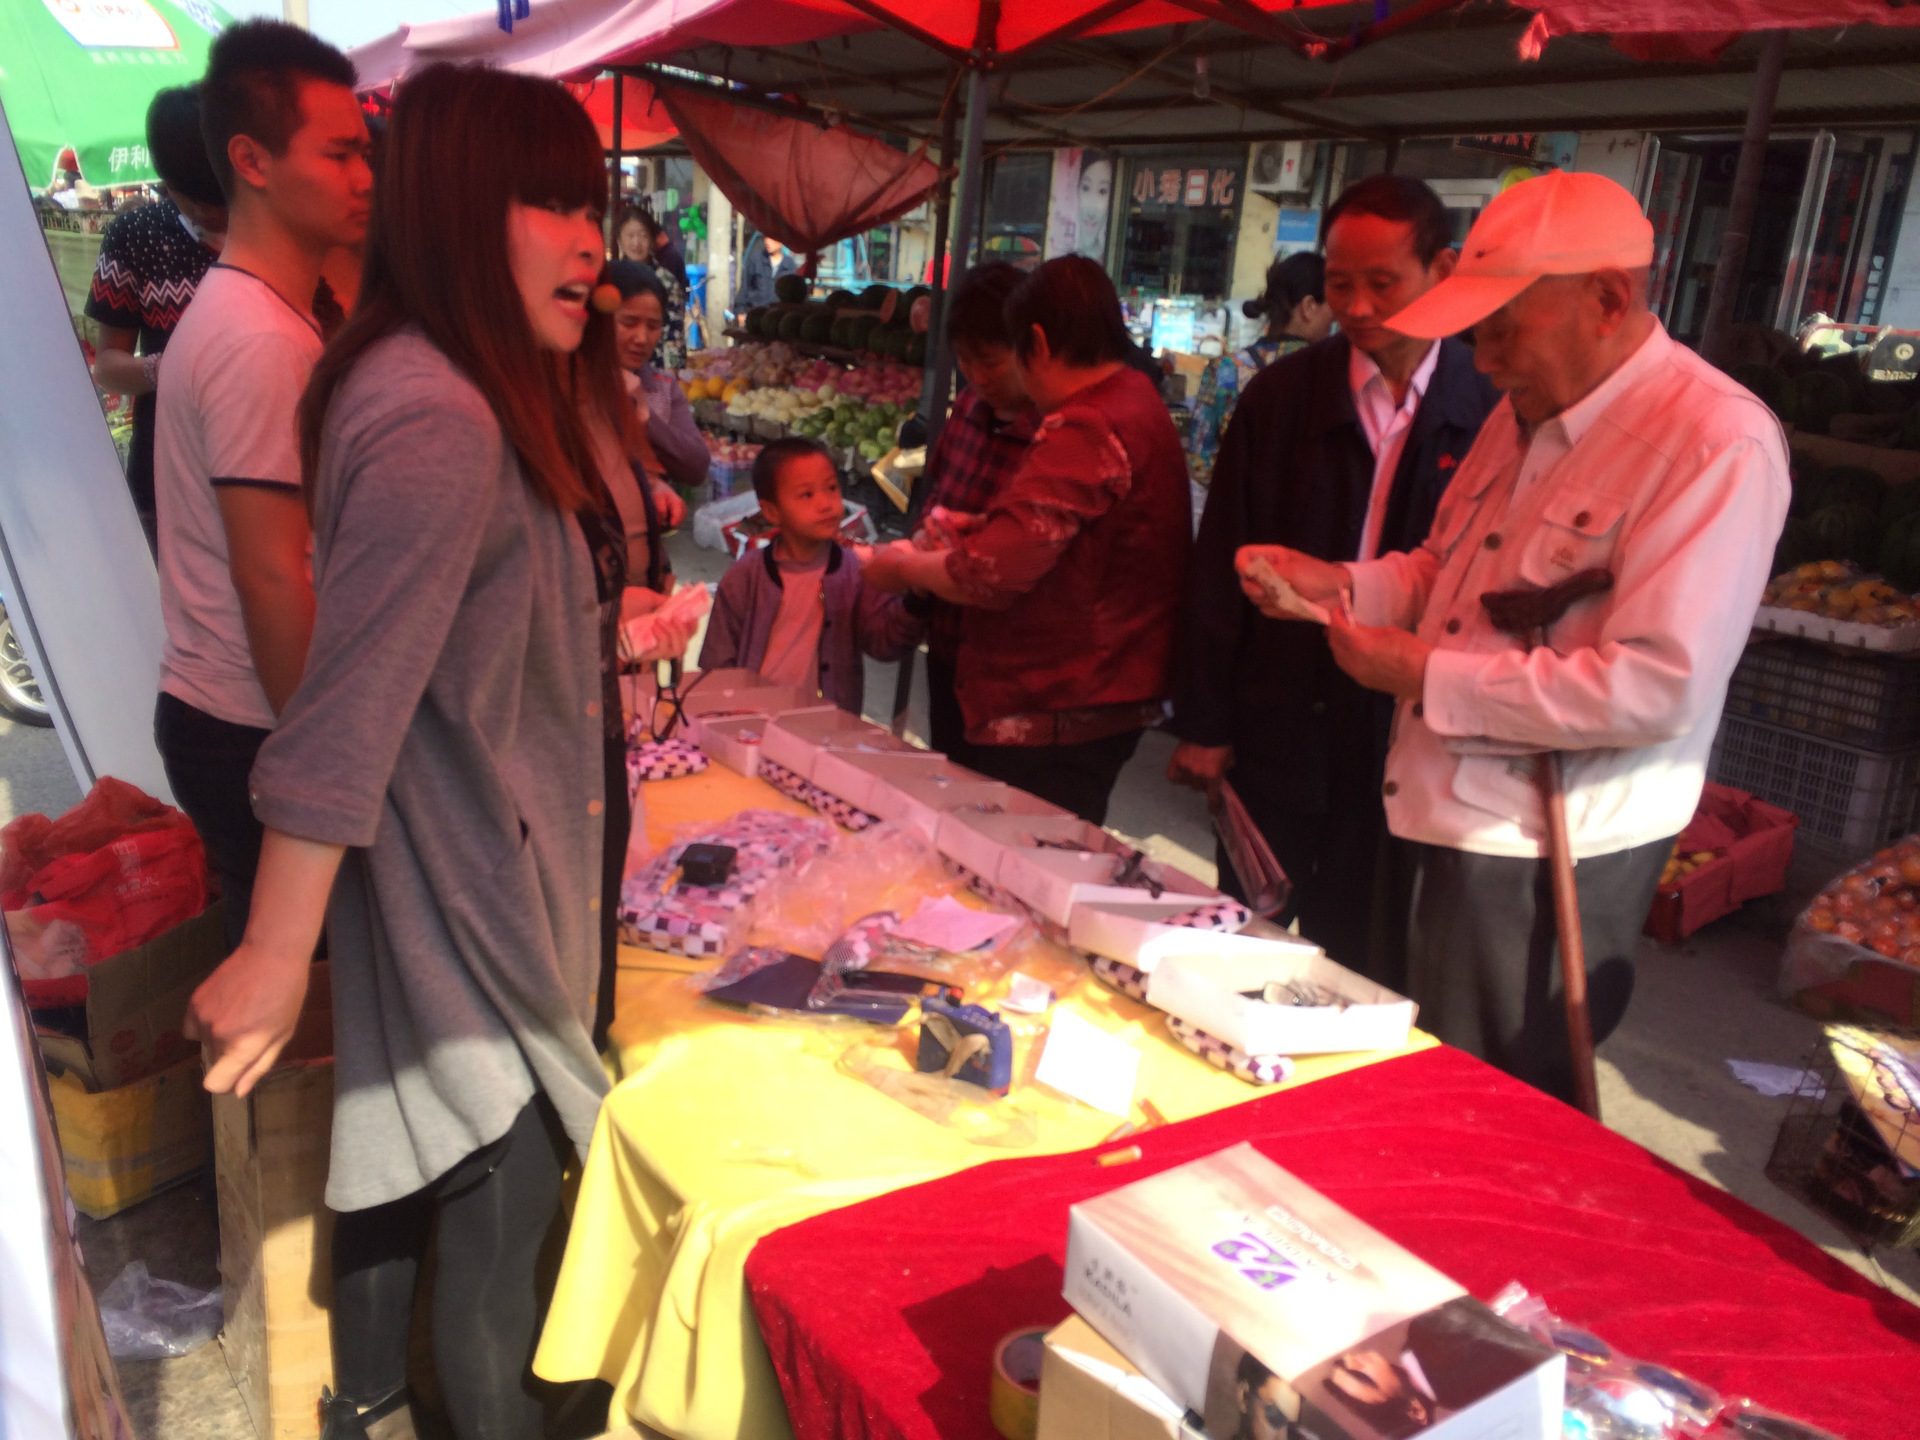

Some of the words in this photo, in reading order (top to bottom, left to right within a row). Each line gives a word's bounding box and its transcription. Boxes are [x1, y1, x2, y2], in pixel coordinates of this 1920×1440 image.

[108, 144, 149, 173] 伊利
[1133, 168, 1236, 206] 小秀日化
